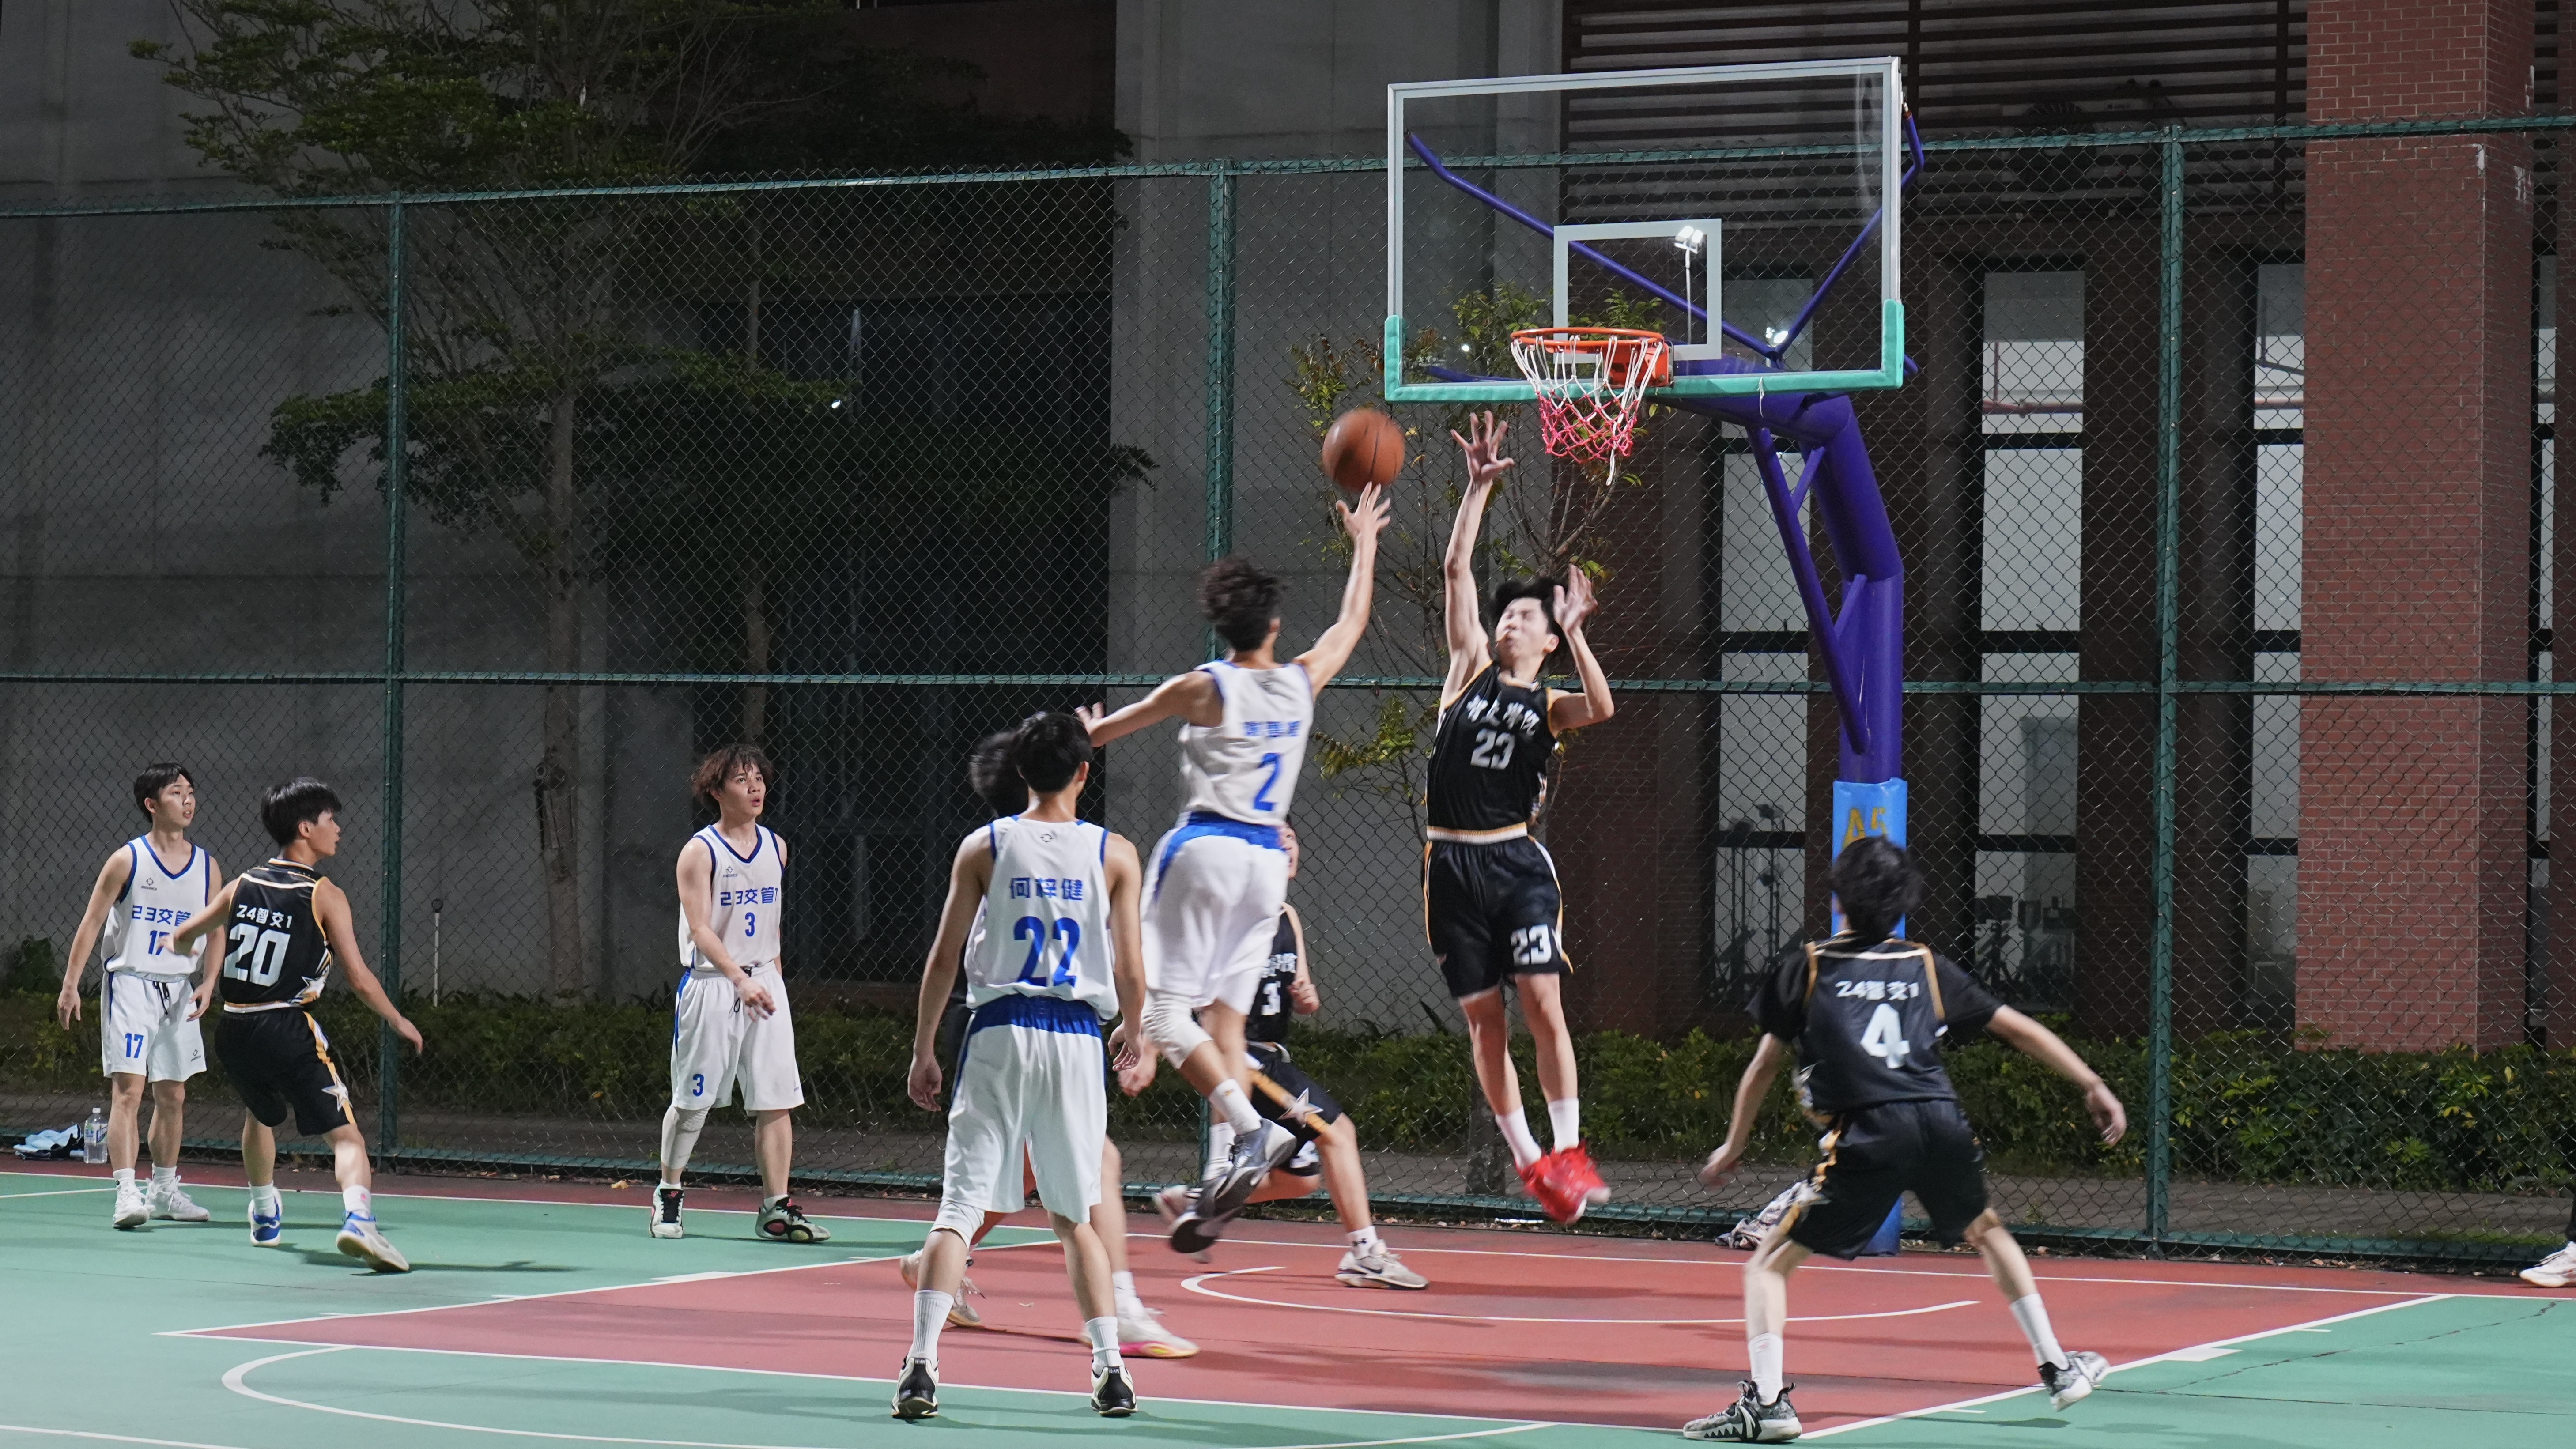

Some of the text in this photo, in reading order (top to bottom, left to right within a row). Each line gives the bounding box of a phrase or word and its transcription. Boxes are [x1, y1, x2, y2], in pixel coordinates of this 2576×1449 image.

[1470, 728, 1515, 770] 23
[1253, 752, 1280, 811] 2
[1009, 877, 1084, 901] 何梓健
[236, 904, 293, 928] 24智交1
[745, 912, 755, 937] 3
[223, 923, 291, 987] 20
[1013, 916, 1080, 988] 22
[1511, 924, 1552, 966] 23
[125, 1033, 144, 1058] 17
[1860, 1003, 1910, 1069] 4
[692, 1073, 704, 1097] 3
